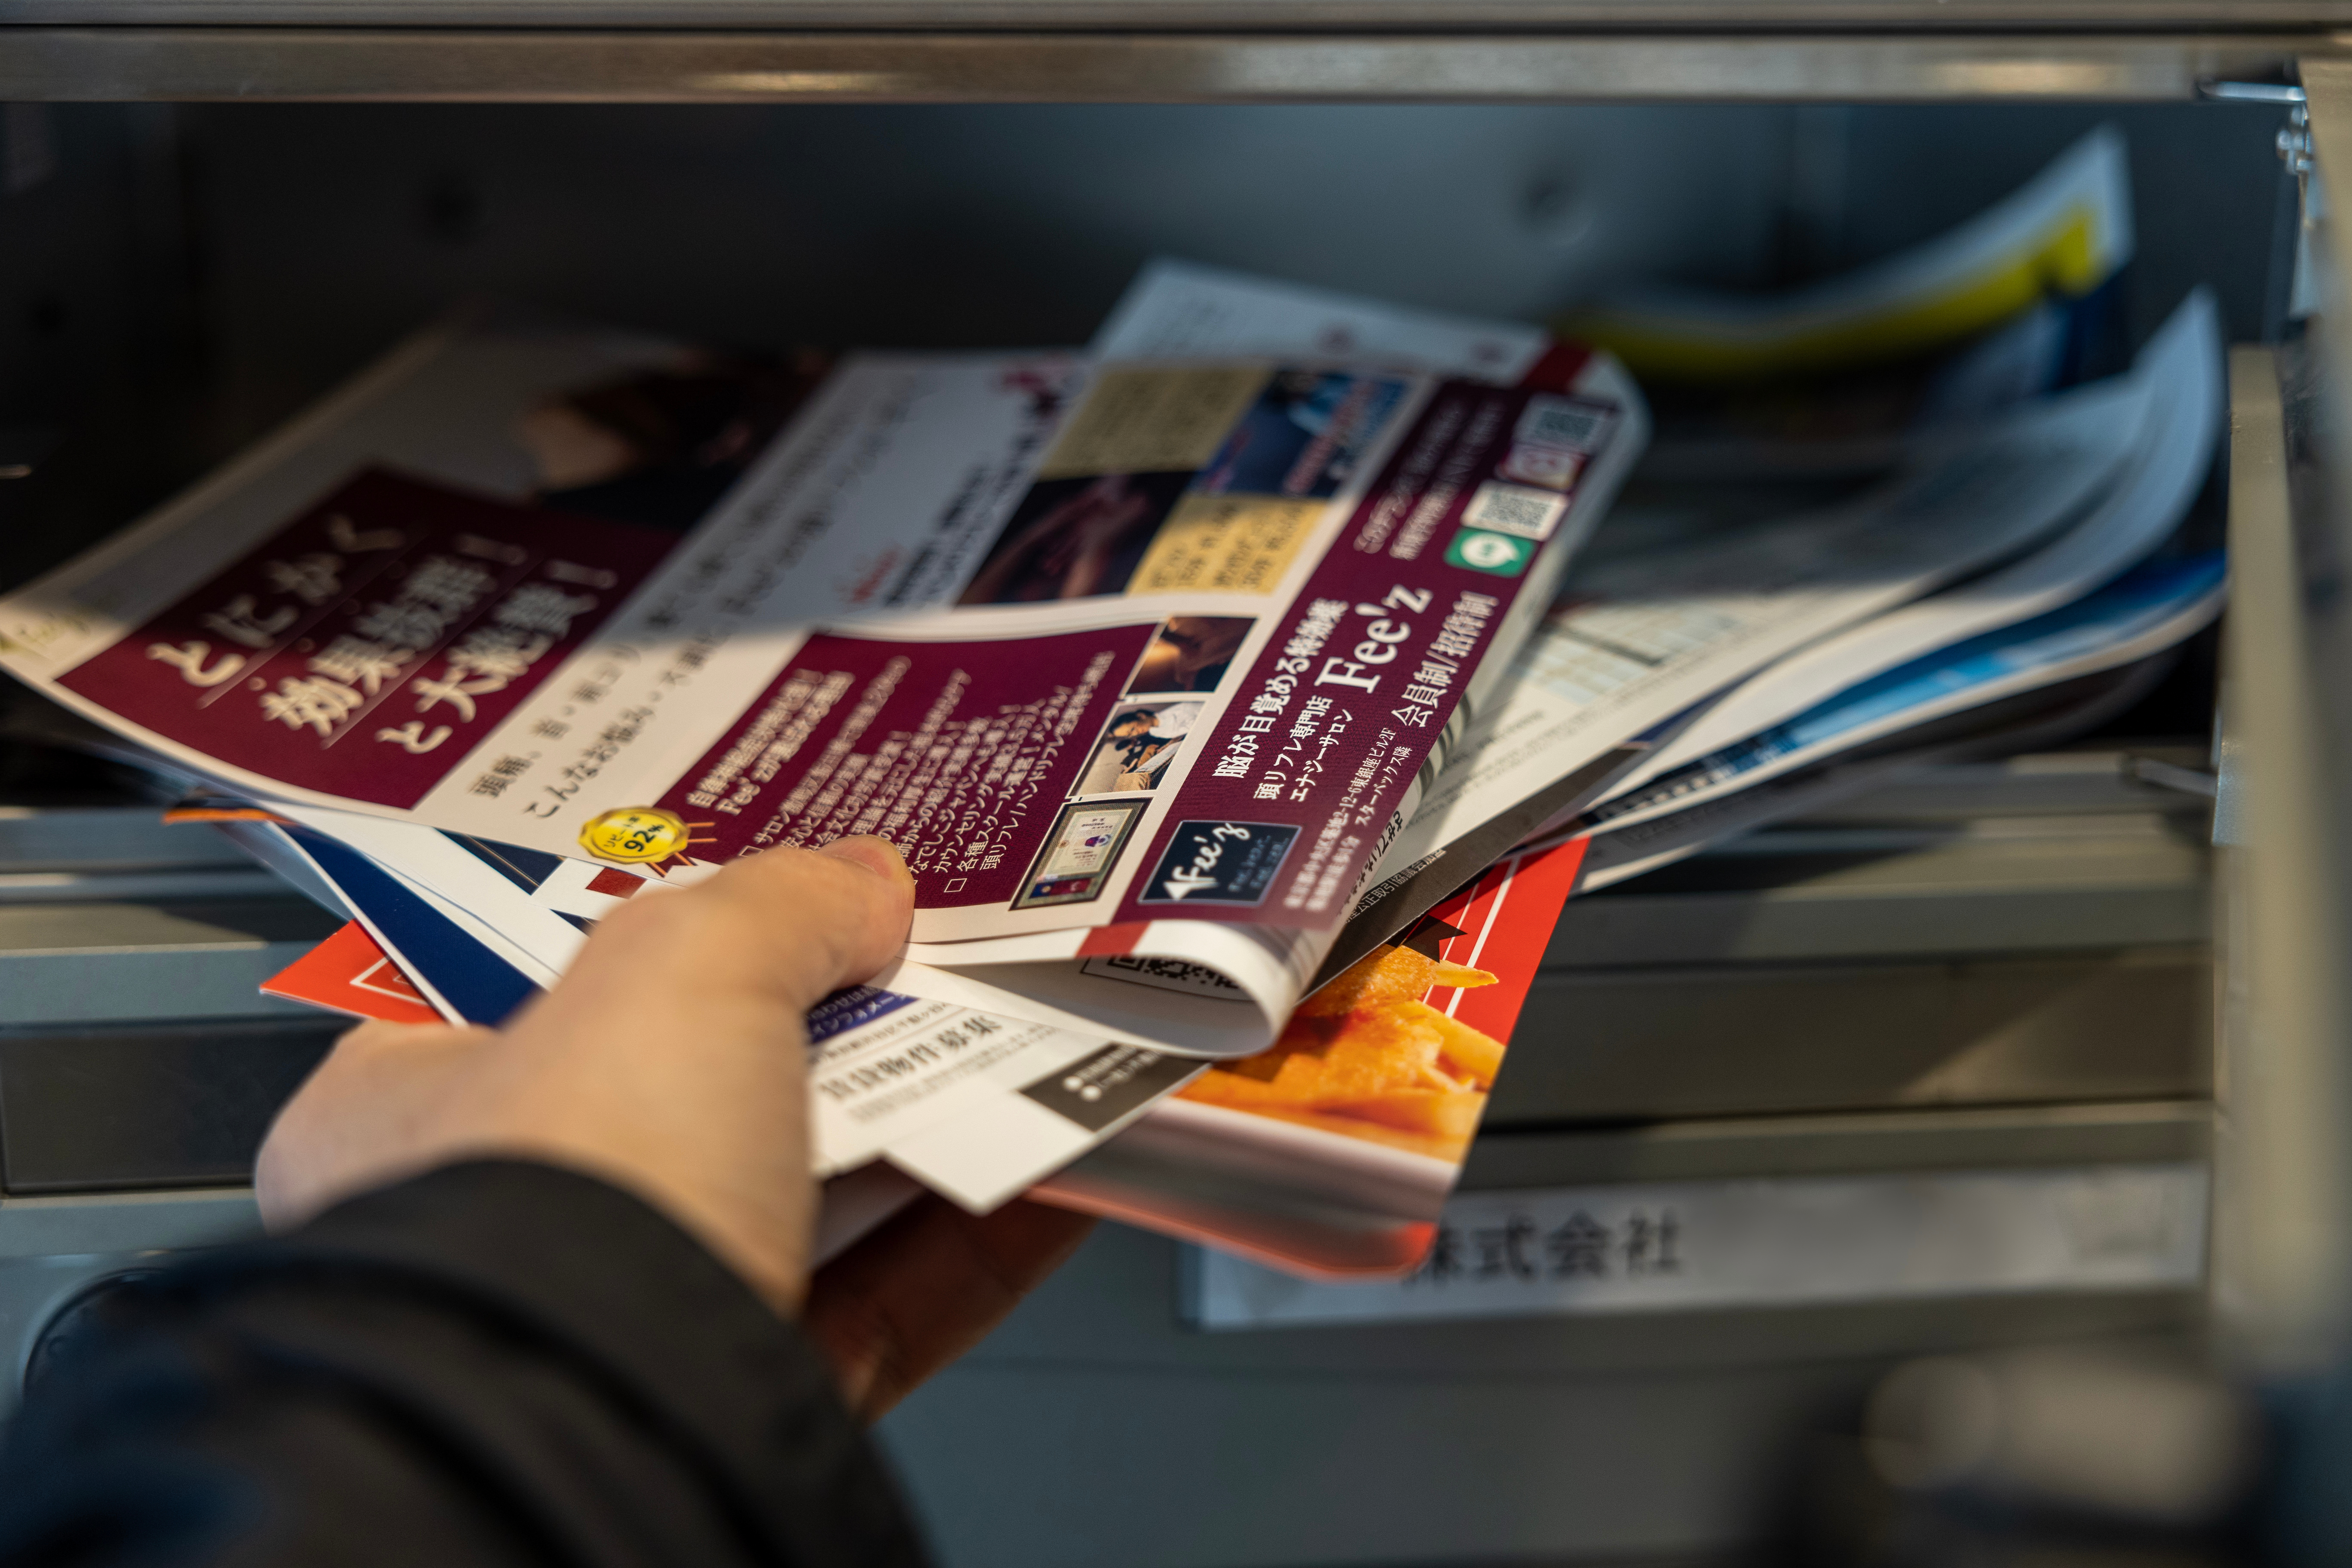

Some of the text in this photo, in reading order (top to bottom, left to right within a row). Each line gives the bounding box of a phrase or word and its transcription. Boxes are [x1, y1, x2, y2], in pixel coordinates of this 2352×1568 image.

[145, 513, 406, 688] とにかく
[1314, 584, 1434, 694] Fee'z
[1212, 597, 1351, 779] 脳が目覚める特効薬
[1253, 694, 1333, 801] 頭リフレ専門店
[1289, 708, 1354, 803] エナジーサロン
[623, 823, 666, 853] 92%
[1346, 848, 1447, 924] 産公正取引協議会加盟
